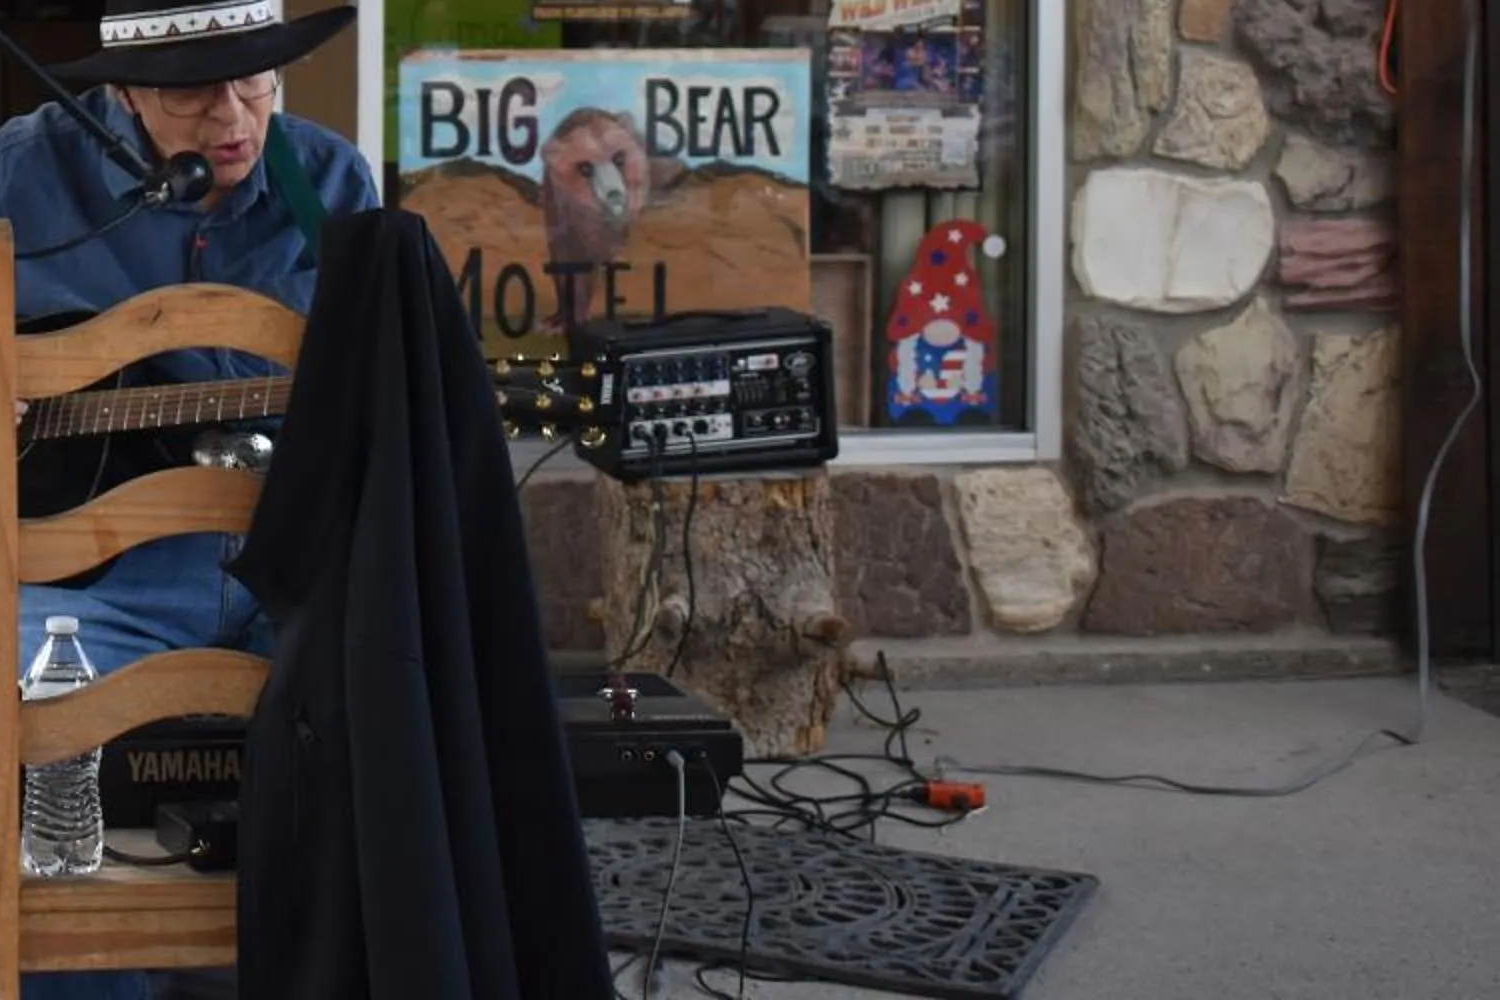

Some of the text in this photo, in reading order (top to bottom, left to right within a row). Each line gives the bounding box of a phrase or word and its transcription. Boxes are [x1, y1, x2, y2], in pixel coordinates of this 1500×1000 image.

[420, 76, 781, 166] BIG BEAR
[127, 749, 241, 783] YAMAHA
